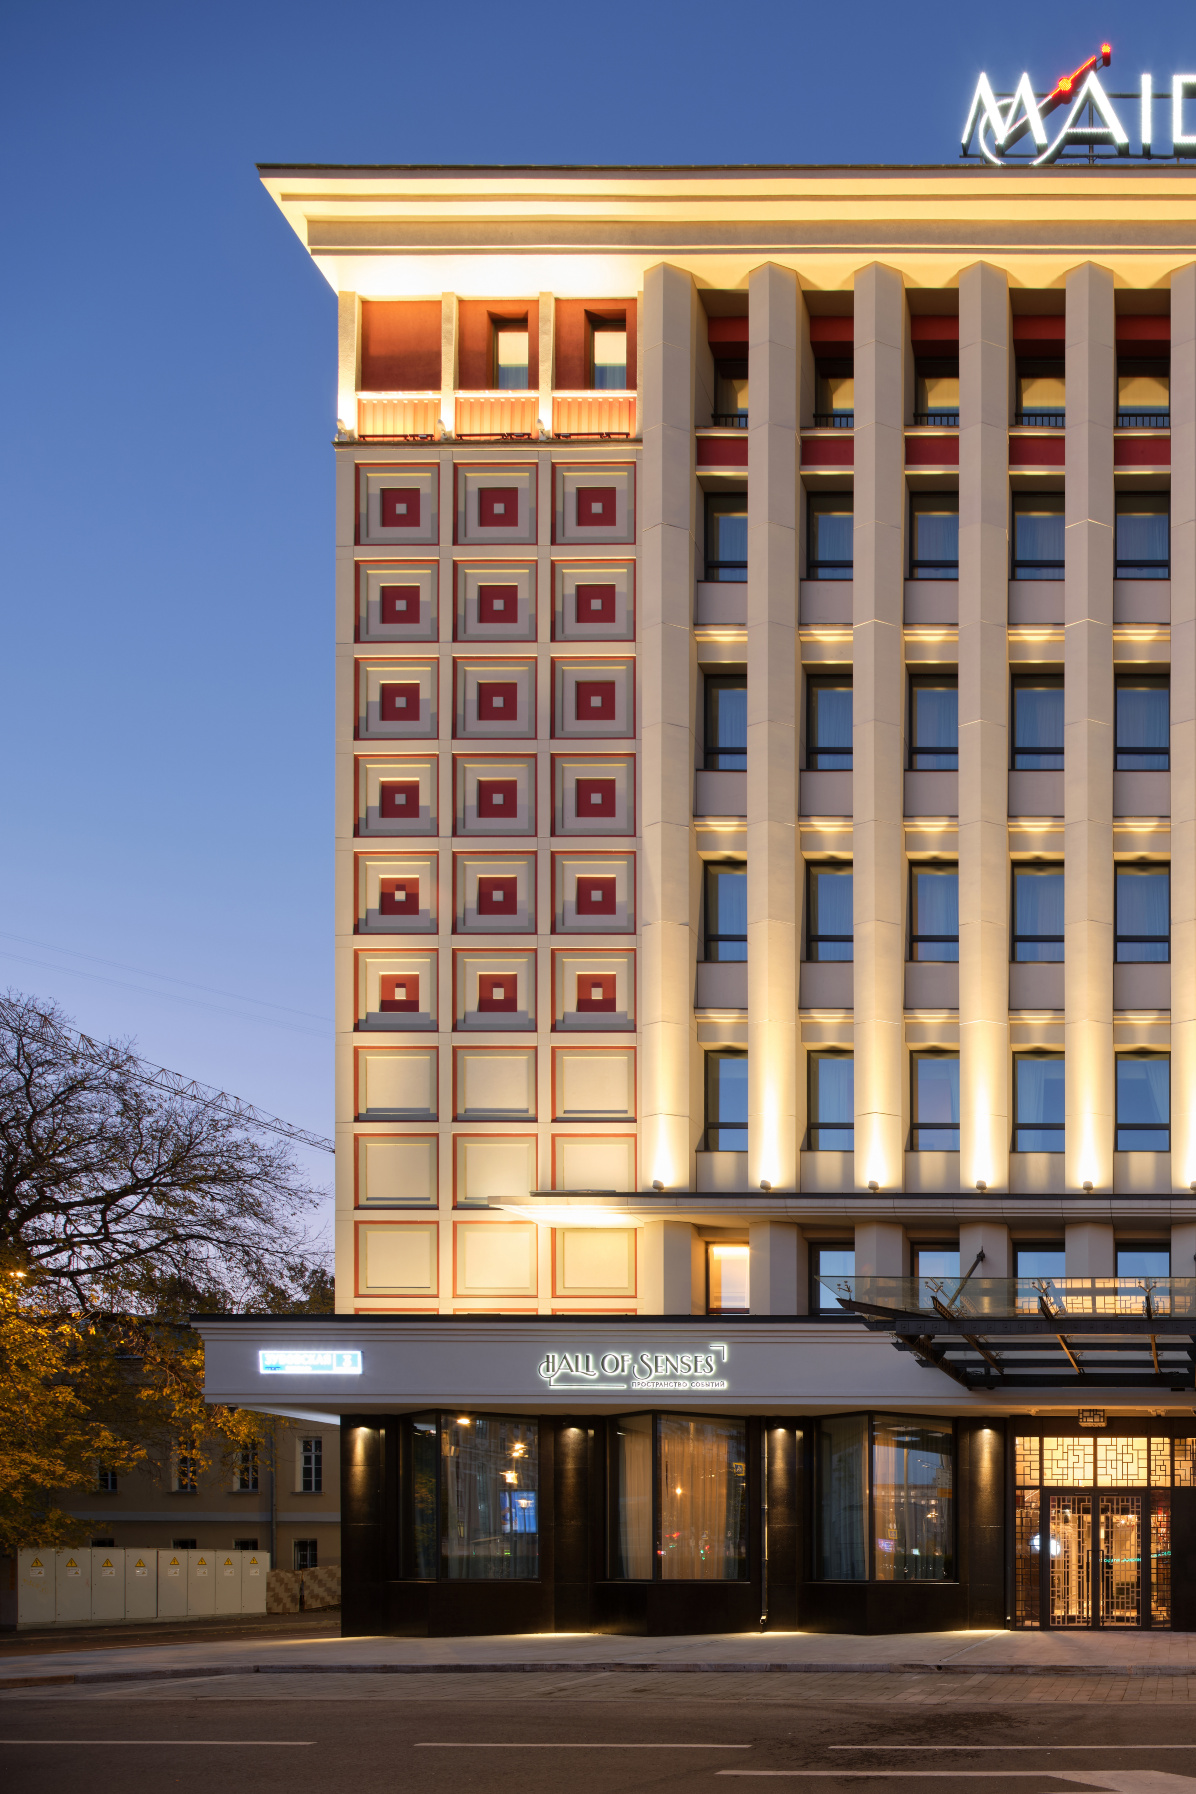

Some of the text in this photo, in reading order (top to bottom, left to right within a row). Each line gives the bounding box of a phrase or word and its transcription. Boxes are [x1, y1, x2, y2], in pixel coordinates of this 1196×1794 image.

[538, 1353, 714, 1380] HALL OF SENSES
[631, 1380, 726, 1389] ПРОСТРАНСТВО СОБЫТИЙ
